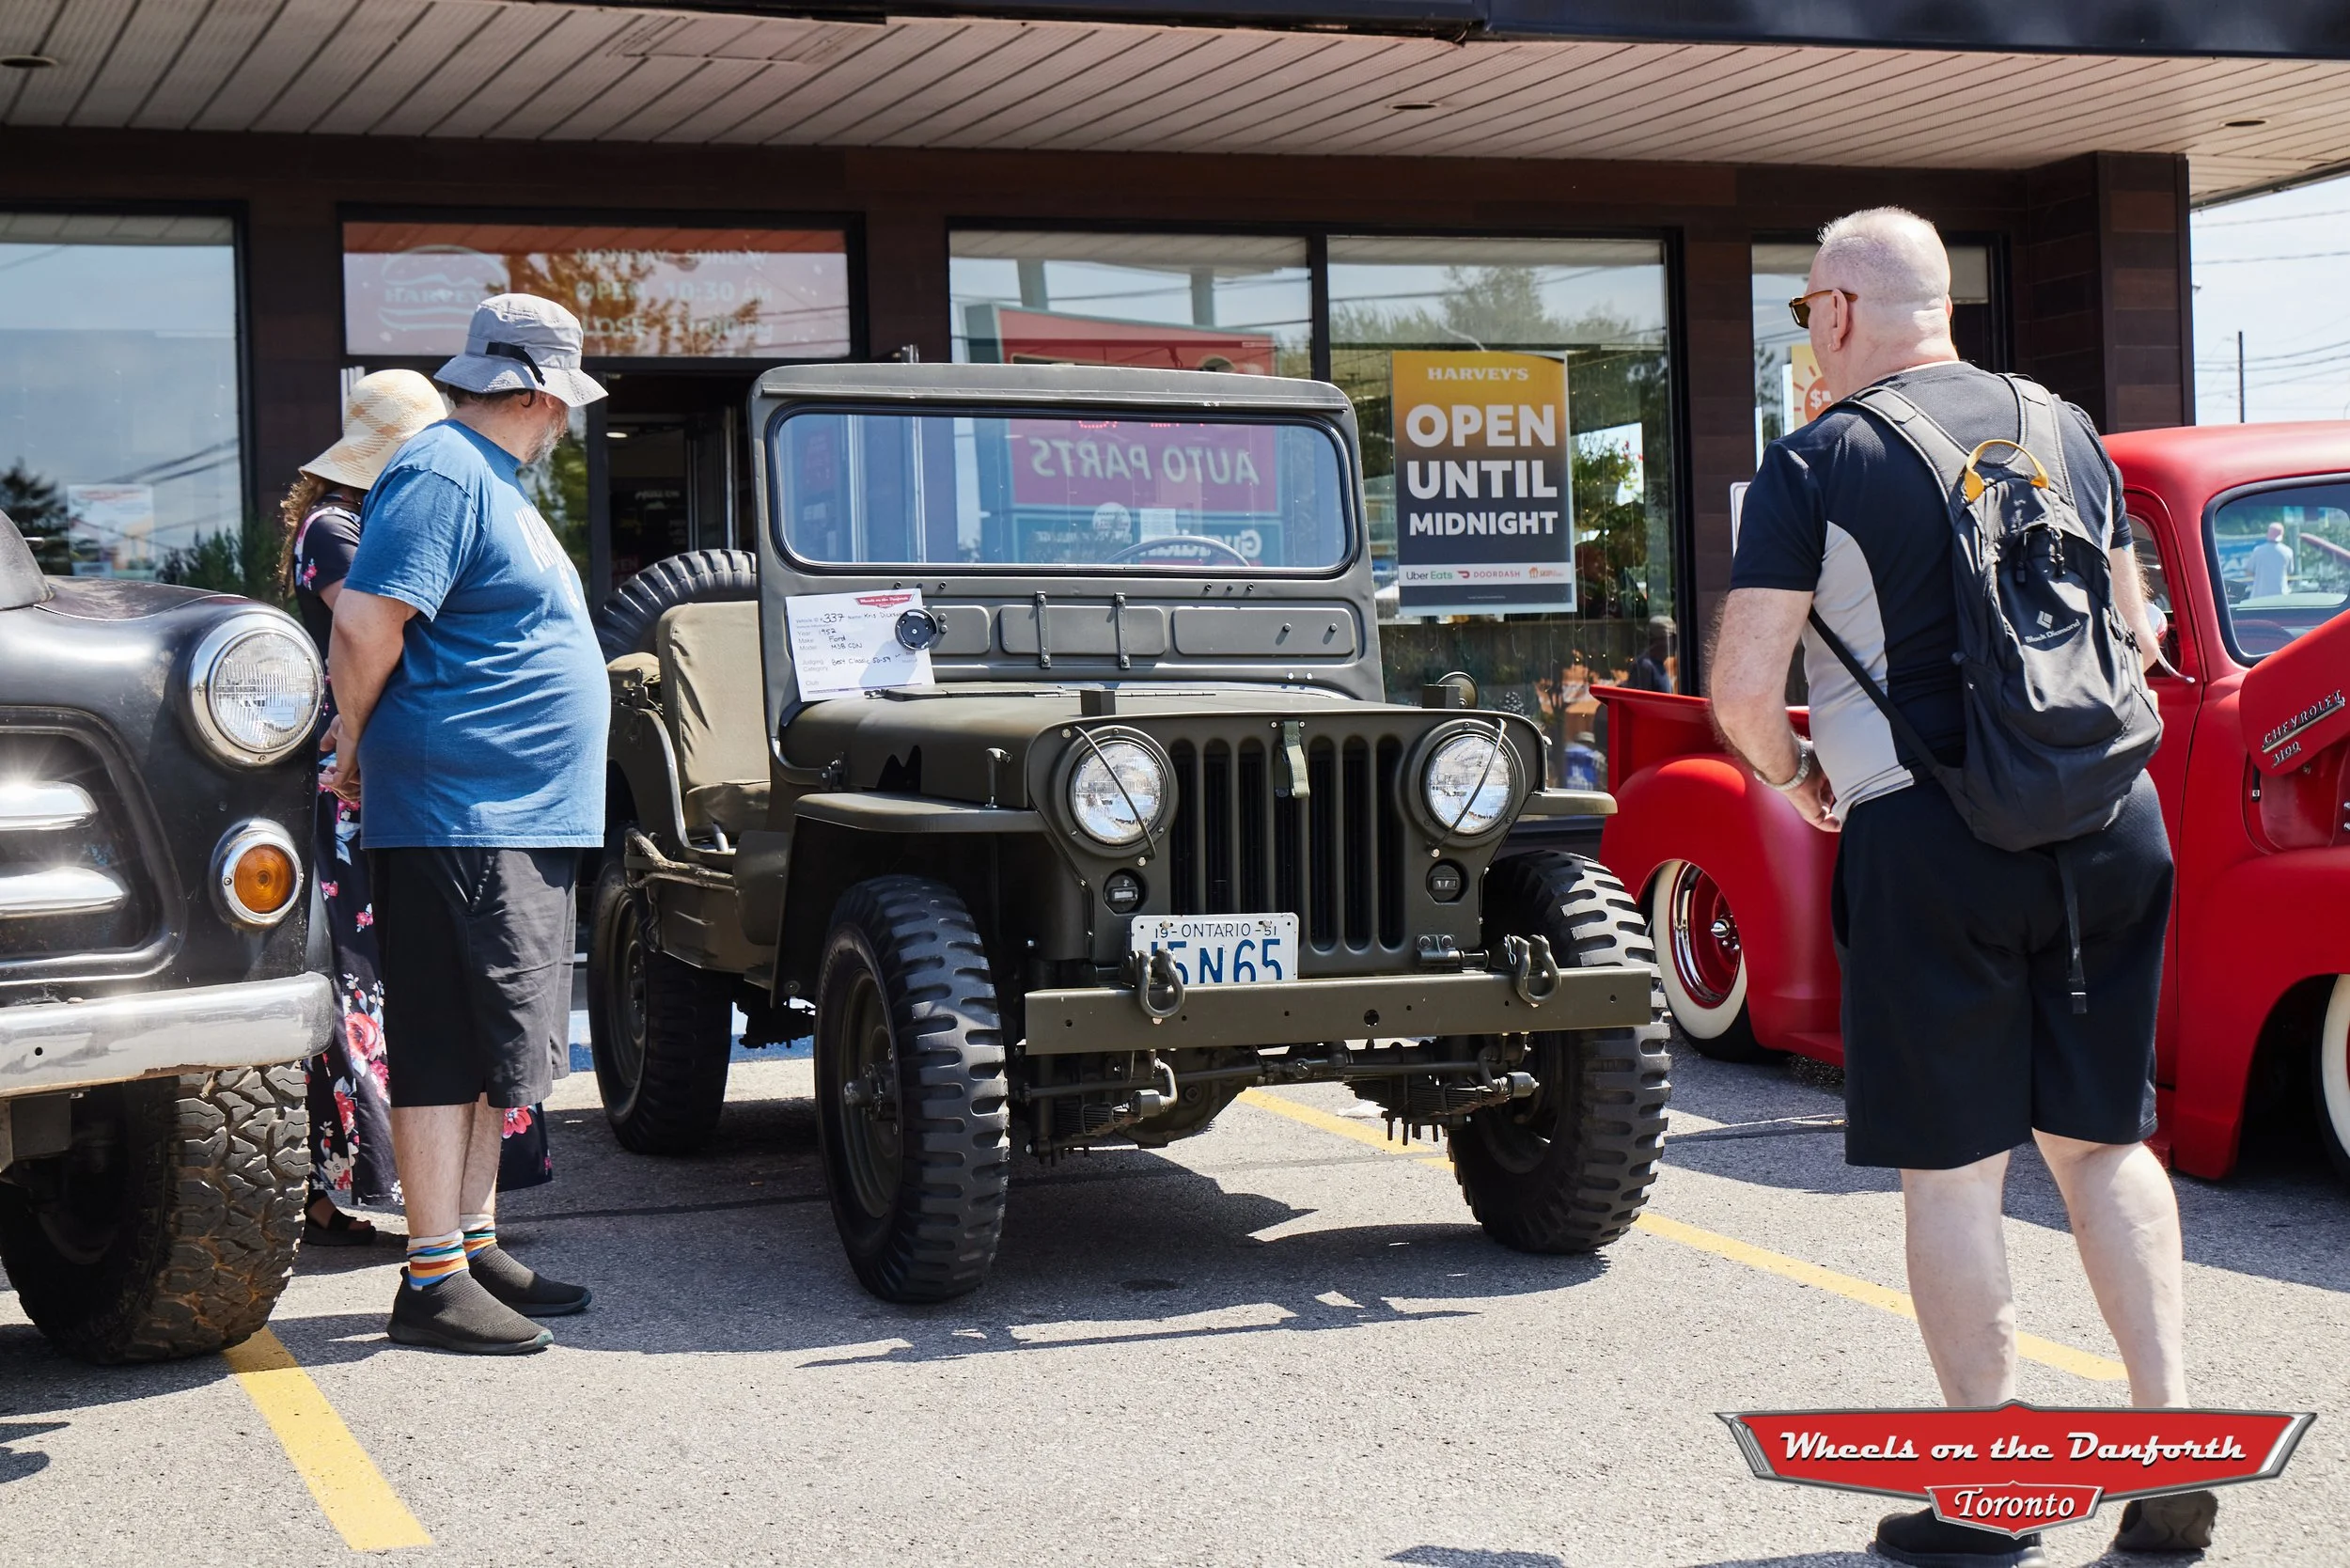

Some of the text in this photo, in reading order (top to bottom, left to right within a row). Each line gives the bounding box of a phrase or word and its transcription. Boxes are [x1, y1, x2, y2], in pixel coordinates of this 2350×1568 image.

[575, 280, 774, 303] OPEN 10:30 AM
[579, 317, 650, 337] LOSE
[1427, 367, 1529, 381] HARVEY'S
[1405, 403, 1557, 448] OPEN
[1407, 460, 1559, 500] UNTIL
[1410, 511, 1559, 536] MIDNIGHT
[1406, 570, 1453, 580] Uber Eats
[1473, 570, 1521, 578] DOORDASH
[822, 613, 845, 623] 337
[2024, 619, 2081, 643] Black Diamond
[2264, 689, 2342, 745] CHEVROLET
[2271, 741, 2302, 768] 3100
